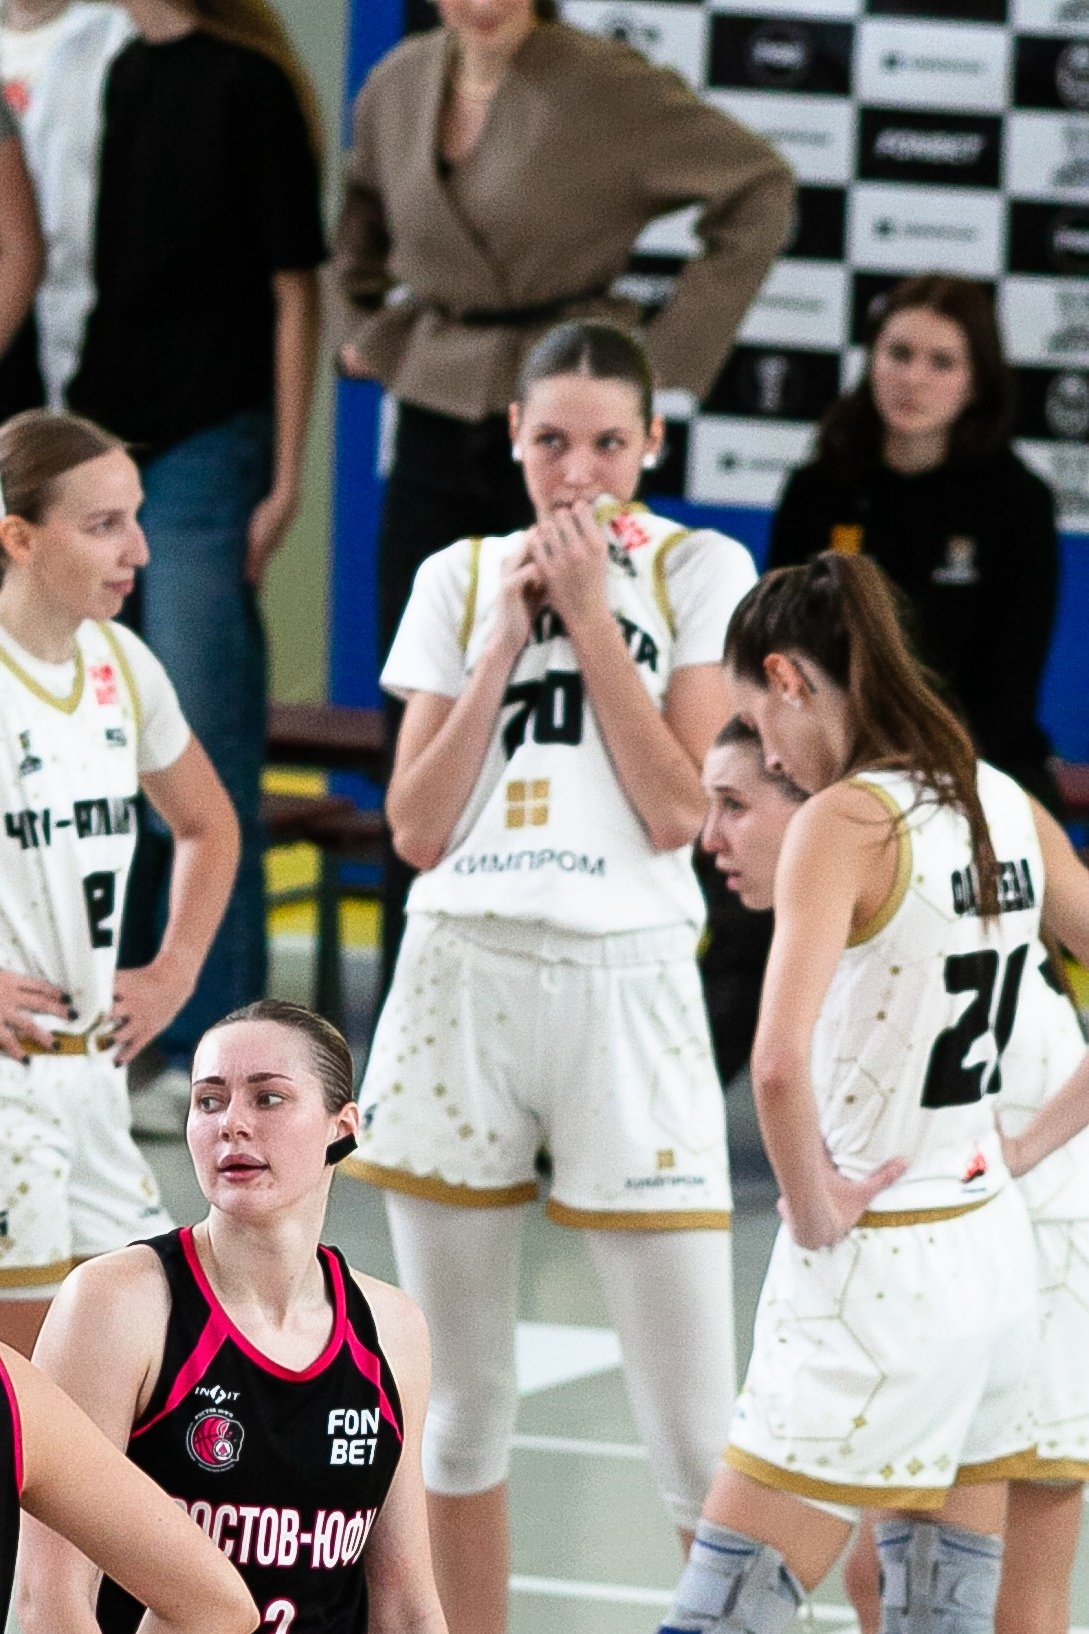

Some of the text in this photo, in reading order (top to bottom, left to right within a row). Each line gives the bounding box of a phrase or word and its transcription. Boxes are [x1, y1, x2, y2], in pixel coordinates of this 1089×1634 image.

[83, 871, 115, 947] 2
[920, 943, 1029, 1109] 21
[327, 1407, 380, 1435] FON
[329, 1438, 378, 1466] BET
